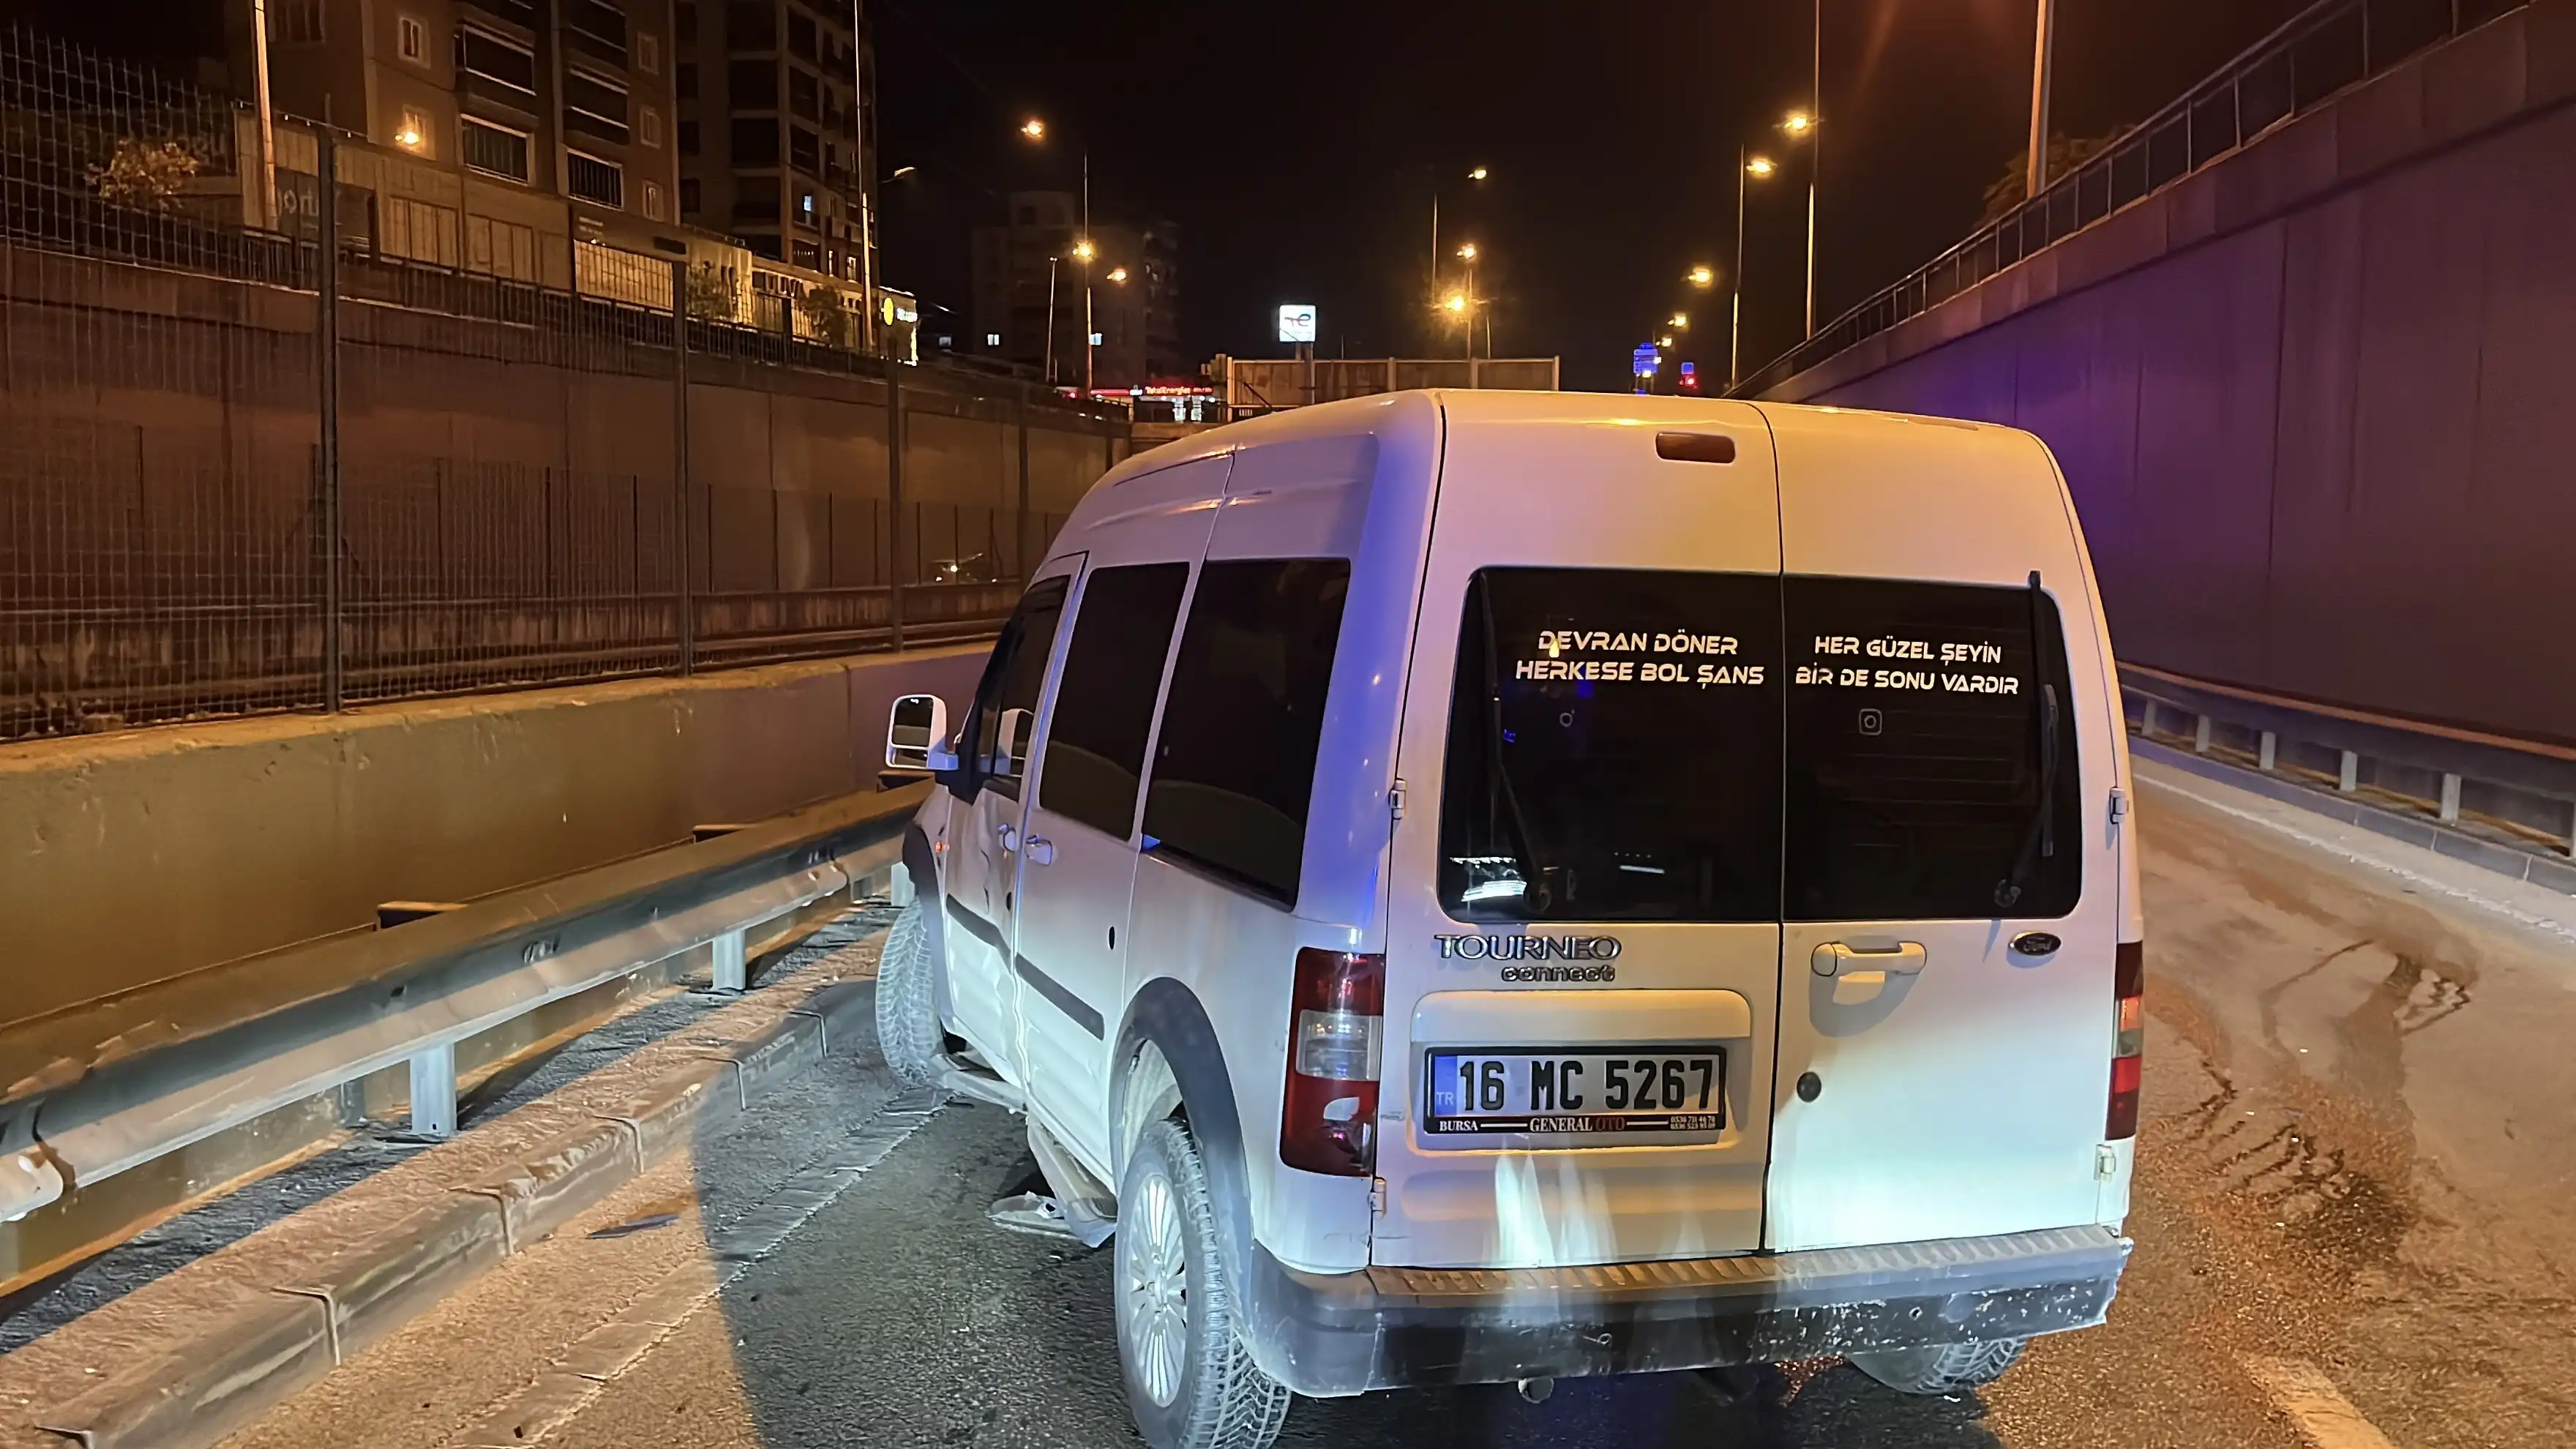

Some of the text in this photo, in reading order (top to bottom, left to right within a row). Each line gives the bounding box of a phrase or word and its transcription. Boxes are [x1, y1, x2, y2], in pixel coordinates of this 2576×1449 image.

[1538, 629, 1738, 655] DEVRAN DÖNER
[1814, 635, 2002, 667] HER GÜZEL ŞEYİN
[1516, 660, 1764, 690] HERKESE BOL ŞANS
[1795, 662, 2019, 694] BİR DE SONU VARDIR
[1434, 934, 1622, 961] TOURNEO
[1501, 965, 1616, 982] connect
[1436, 1091, 1455, 1106] TR
[1460, 1060, 1714, 1111] 16 MC 5267
[1439, 1117, 1625, 1132] BURSA GENERAL OTO
